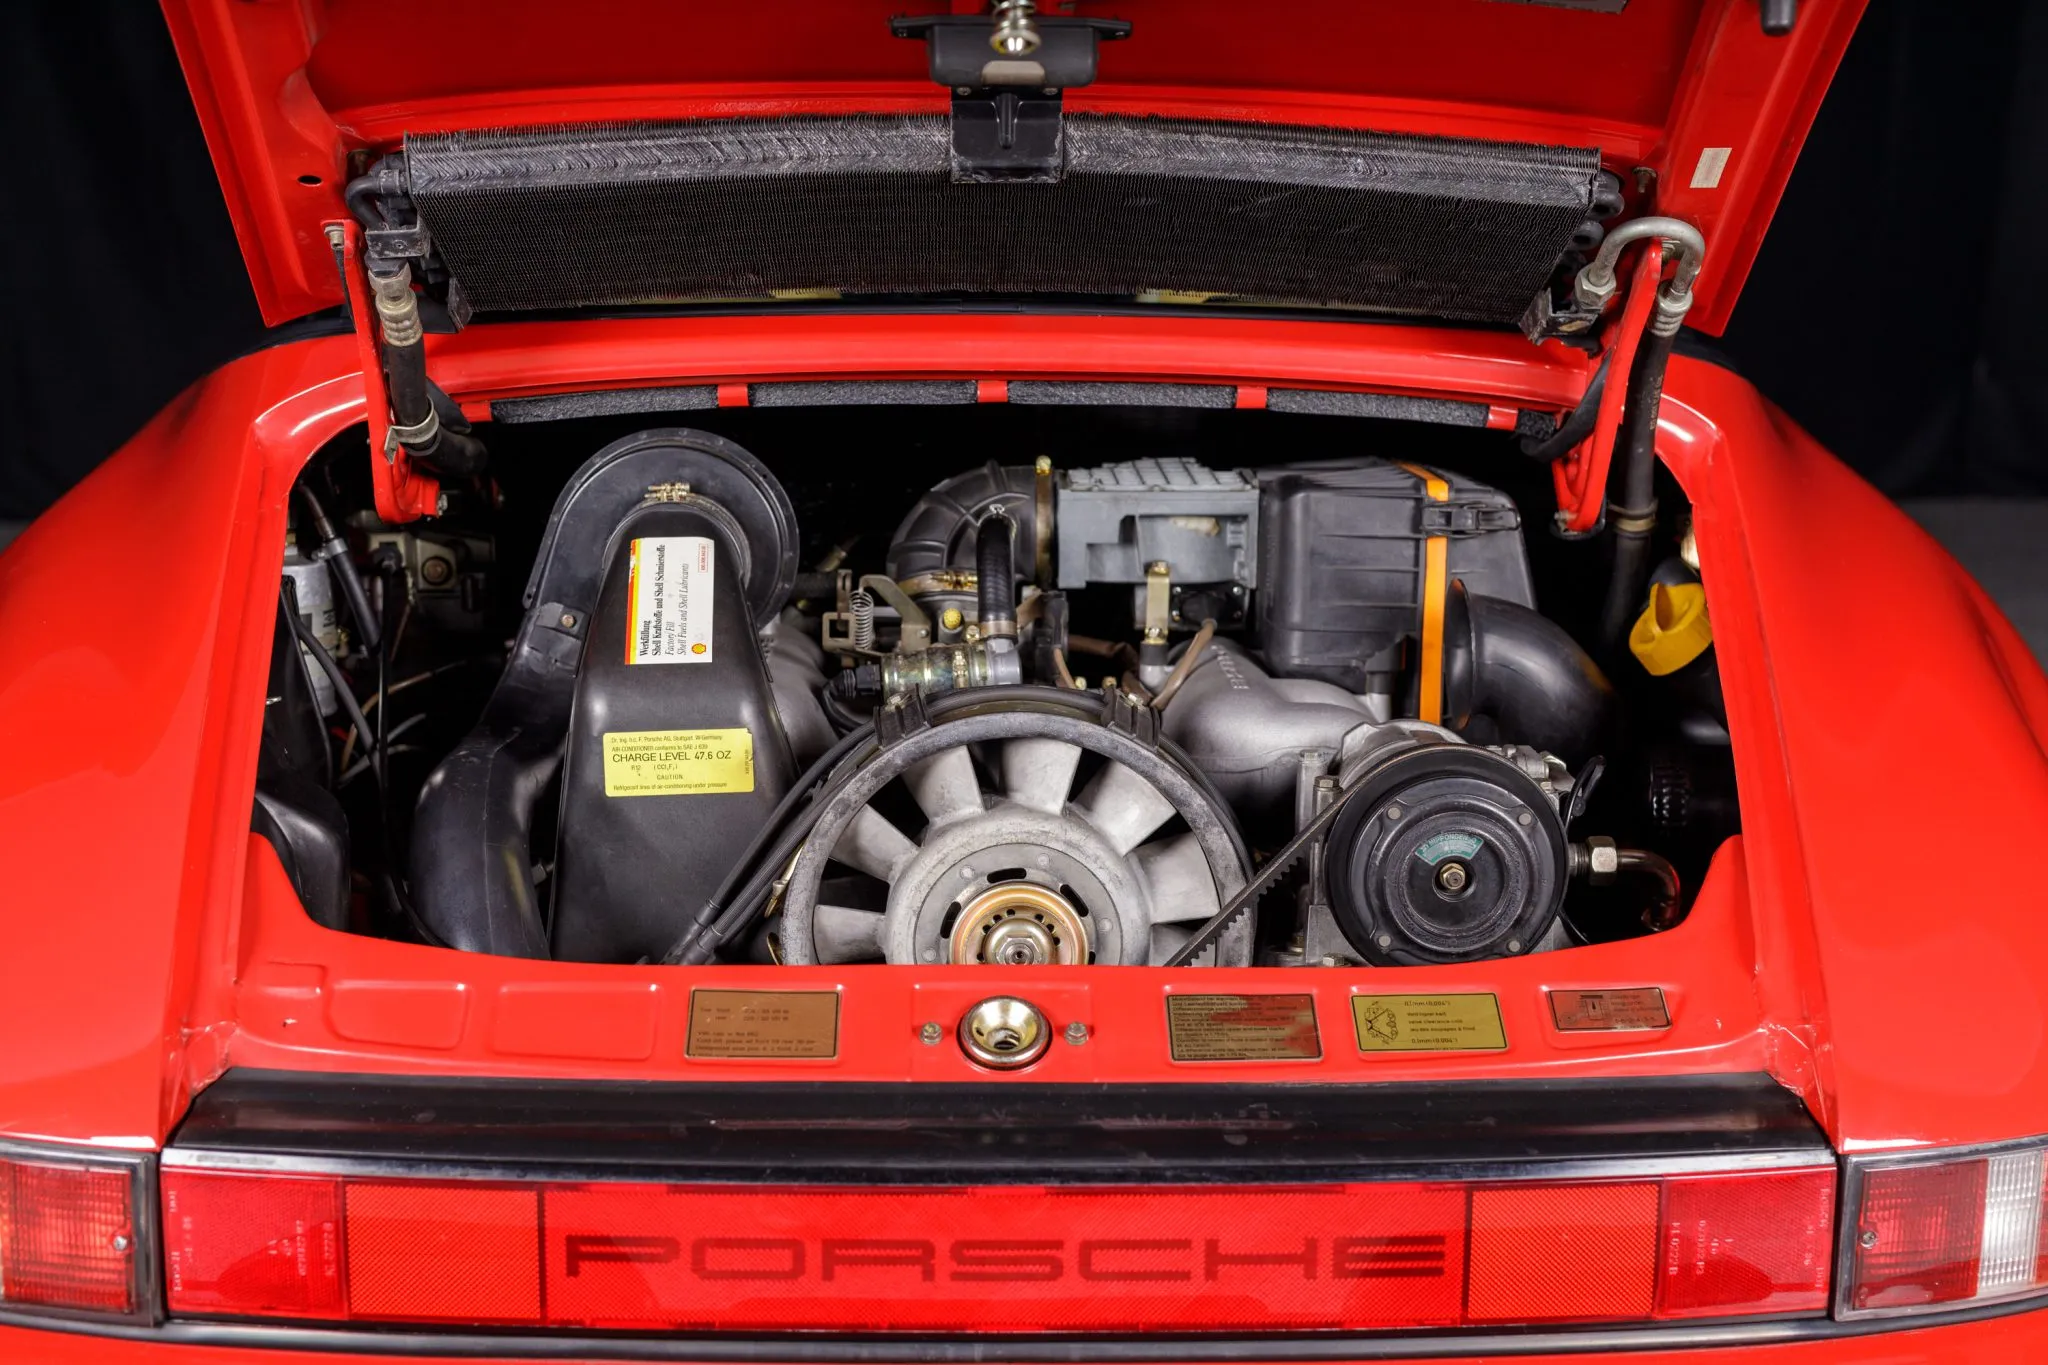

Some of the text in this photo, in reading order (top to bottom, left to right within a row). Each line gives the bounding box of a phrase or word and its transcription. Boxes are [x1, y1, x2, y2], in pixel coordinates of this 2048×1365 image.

[680, 563, 689, 593] Lubricants
[652, 545, 665, 656] Shell Kraftstoffe und Shell Schmierstoffe
[679, 594, 688, 609] Shell
[640, 621, 650, 656] Werkfüllung
[665, 622, 676, 655] Factory Fill
[678, 623, 687, 638] Fuels
[678, 640, 686, 655] Shell
[612, 750, 731, 763] CHARGE LEVEL 47.6 OZ
[565, 1235, 1445, 1283] PORSCHE
